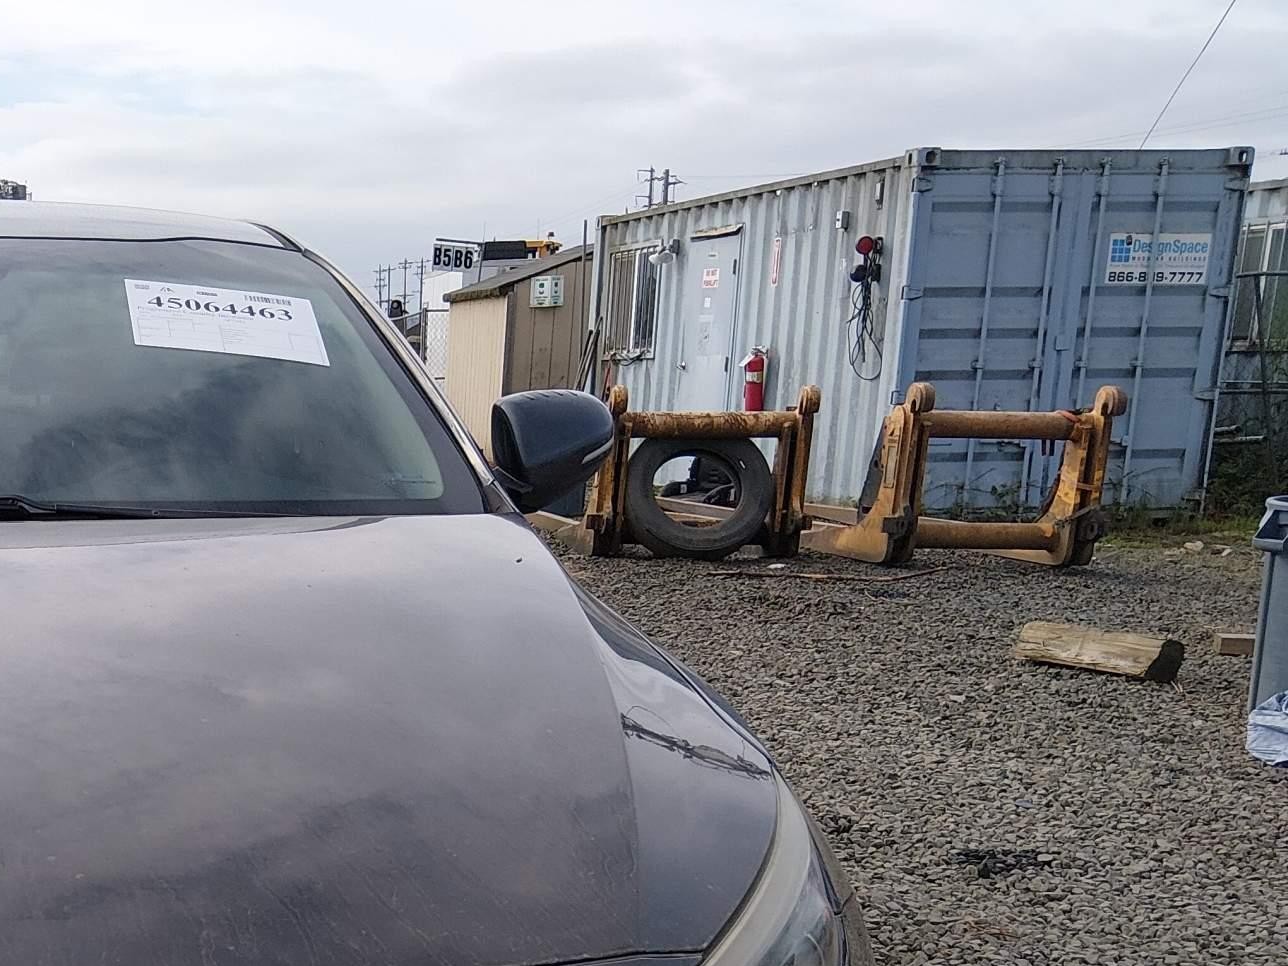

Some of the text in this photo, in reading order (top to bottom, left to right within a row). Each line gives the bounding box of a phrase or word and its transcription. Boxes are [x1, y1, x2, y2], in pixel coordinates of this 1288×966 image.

[1133, 239, 1208, 256] DesgnSpace
[1108, 271, 1203, 283] 866-89-7777
[147, 295, 293, 321] 45064463
